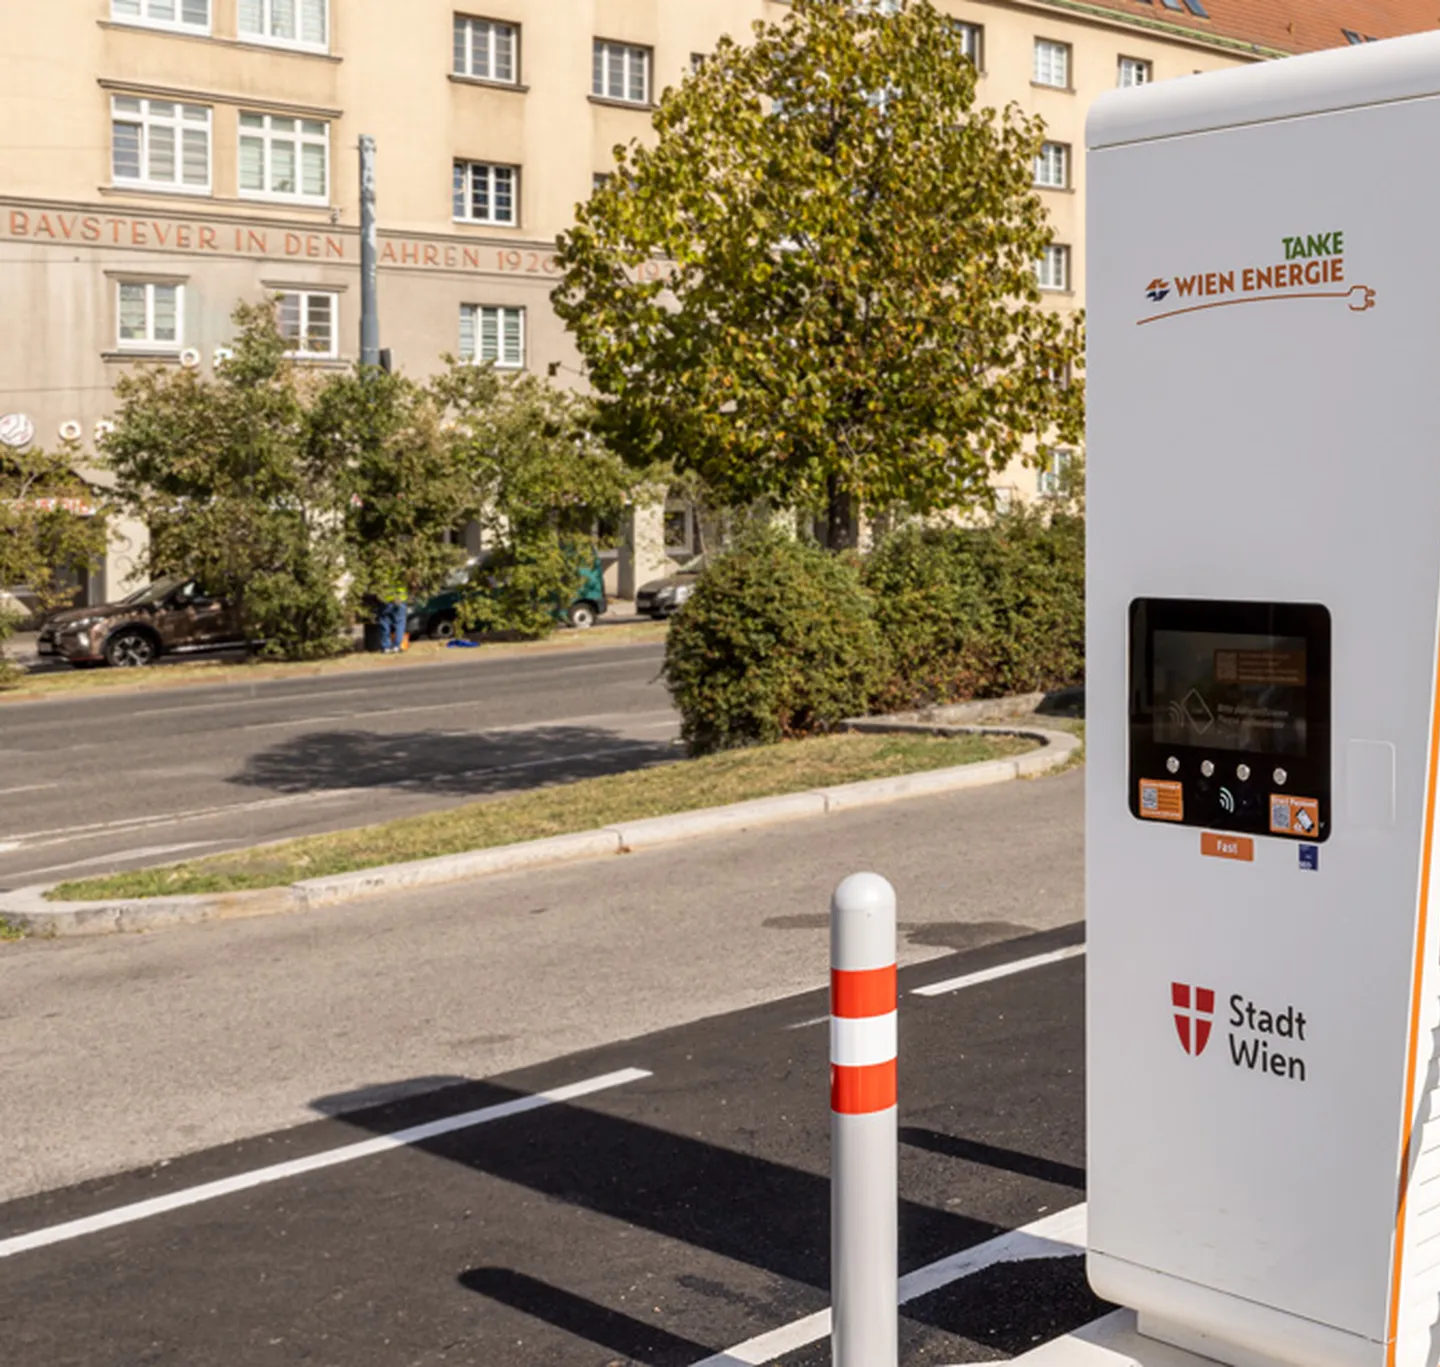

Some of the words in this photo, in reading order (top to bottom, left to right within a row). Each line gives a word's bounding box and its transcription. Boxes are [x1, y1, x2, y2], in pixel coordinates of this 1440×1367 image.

[235, 228, 268, 254] IN
[285, 231, 345, 259] DEN
[380, 240, 480, 268] AHREN
[1281, 231, 1344, 260] TANKE
[1173, 270, 1235, 298] WIEN
[1241, 257, 1344, 292] ENERGIE
[1229, 993, 1307, 1042] Stadt
[1228, 1032, 1306, 1082] Wien
